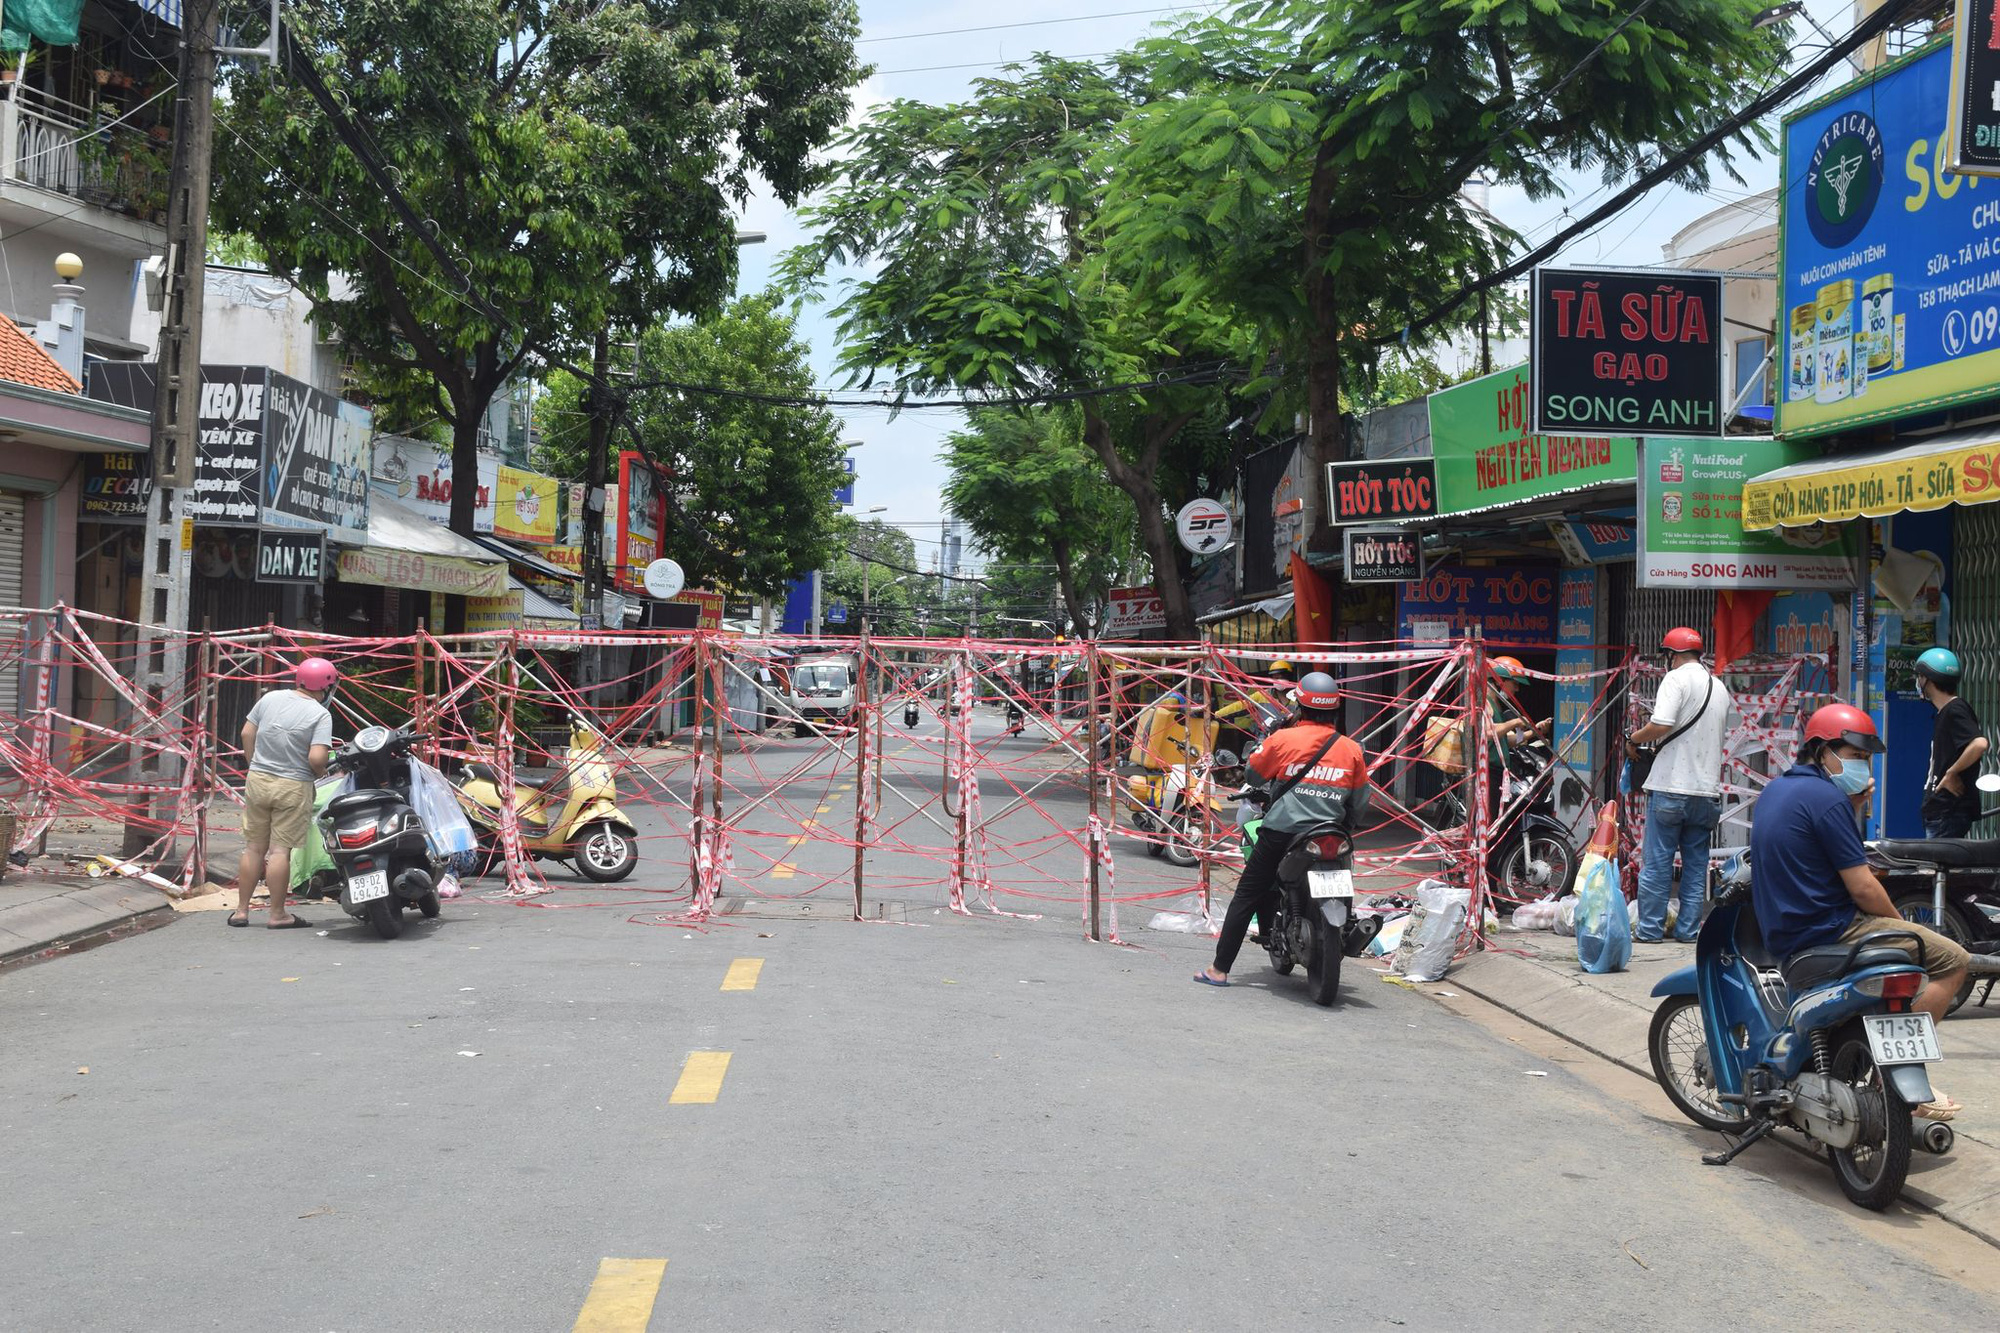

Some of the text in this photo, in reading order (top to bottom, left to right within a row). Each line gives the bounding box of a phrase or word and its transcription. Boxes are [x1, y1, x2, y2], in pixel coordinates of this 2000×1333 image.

[1808, 114, 1882, 186] NUTRICARE
[1801, 266, 1820, 287] NUÔI
[1821, 259, 1838, 279] CON
[1863, 243, 1887, 265] TÊNH
[1927, 253, 1950, 277] SỮA
[1975, 237, 1990, 261] VÀ
[1919, 289, 1936, 310] 158
[1938, 277, 1975, 303] THẠCH
[1551, 281, 1710, 344] TÃ SỮA
[1870, 317, 1886, 333] 100
[1593, 351, 1669, 387] GẠO
[199, 383, 264, 421] KEO XE
[269, 386, 291, 416] Hải
[1547, 394, 1714, 426] SONG ANH
[201, 427, 256, 446] YÊN XE
[303, 397, 333, 460] DÁN
[103, 452, 134, 471] Hải
[1691, 453, 1744, 466] NutiFood
[1691, 469, 1748, 480] GrowPLUS+
[87, 477, 152, 495] DECAL
[415, 469, 453, 504] BẢO
[1338, 466, 1431, 517] HỚT TÓC
[1691, 491, 1710, 502] Sữa
[1773, 482, 1795, 520] CỬA
[1799, 481, 1829, 517] HÀNG
[1832, 483, 1856, 517] TẠP
[1859, 472, 1885, 510] HÓA
[1896, 467, 1914, 505] TÃ
[1927, 461, 1955, 501] SỮA
[1691, 503, 1711, 519] SỐ
[1713, 510, 1722, 519] 1
[261, 538, 320, 578] DÁN XE
[1353, 536, 1417, 565] HỚT TÓC
[384, 551, 425, 585] 169
[1354, 564, 1416, 577] NGUYỄN HOÀNG
[1650, 568, 1665, 577] Cửa
[1667, 567, 1688, 579] Hàng
[1691, 563, 1737, 578] SONG
[1741, 564, 1777, 578] ANH
[1404, 568, 1553, 605] HỚT TÓC
[704, 596, 723, 612] XUẤT
[1116, 600, 1165, 616] 170
[1311, 696, 1338, 705] LOSHIP
[1294, 786, 1315, 797] GIAO
[354, 874, 382, 891] 59-D2
[353, 886, 386, 902] 494.24
[1876, 1018, 1925, 1038] 77-S2
[1882, 1038, 1929, 1060] 6631
